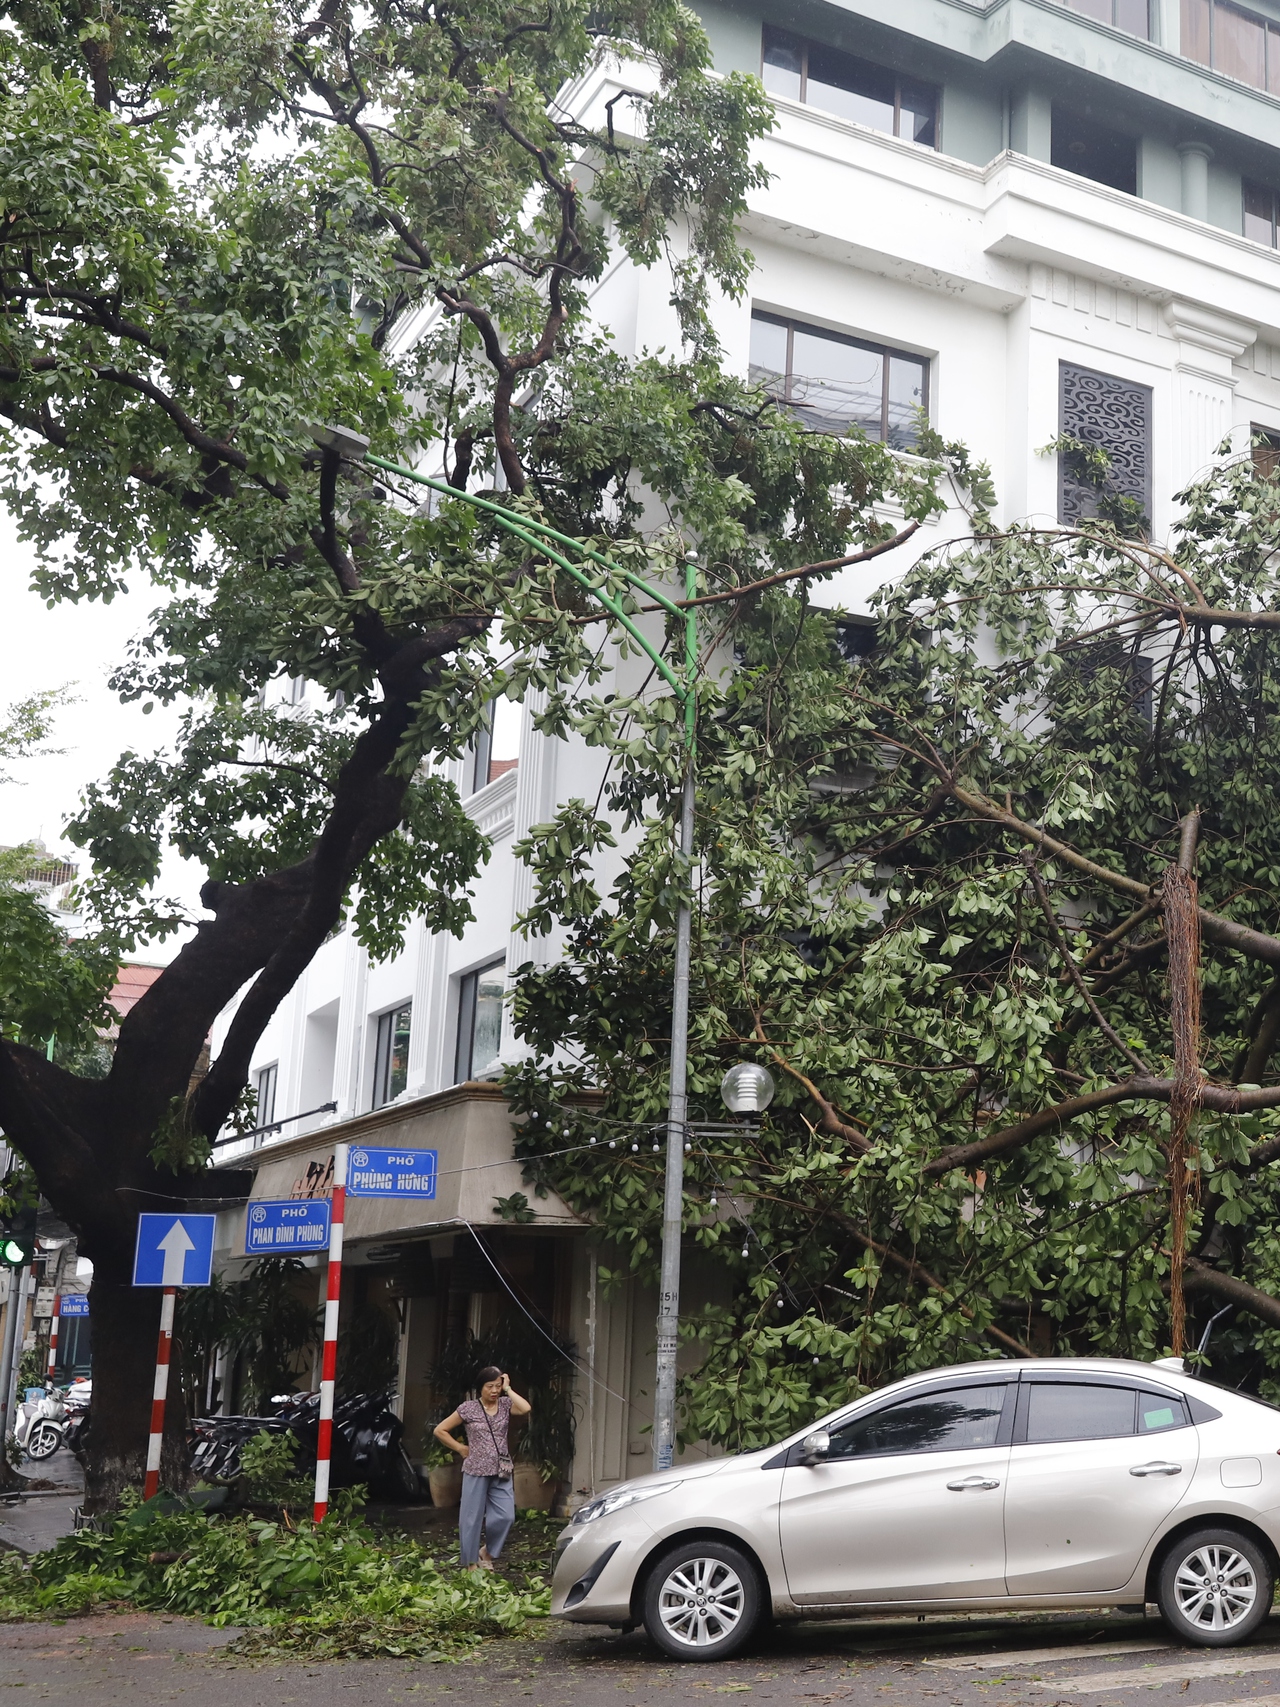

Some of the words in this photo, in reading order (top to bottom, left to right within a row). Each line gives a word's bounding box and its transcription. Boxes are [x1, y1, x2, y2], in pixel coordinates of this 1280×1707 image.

[387, 1154, 416, 1166] PHỐ
[353, 1168, 393, 1190] PHÙNG
[281, 1204, 309, 1218] PHỐ
[252, 1226, 274, 1245] PHAN
[275, 1222, 295, 1243] ĐÌNH
[296, 1221, 324, 1242] PHÙNG
